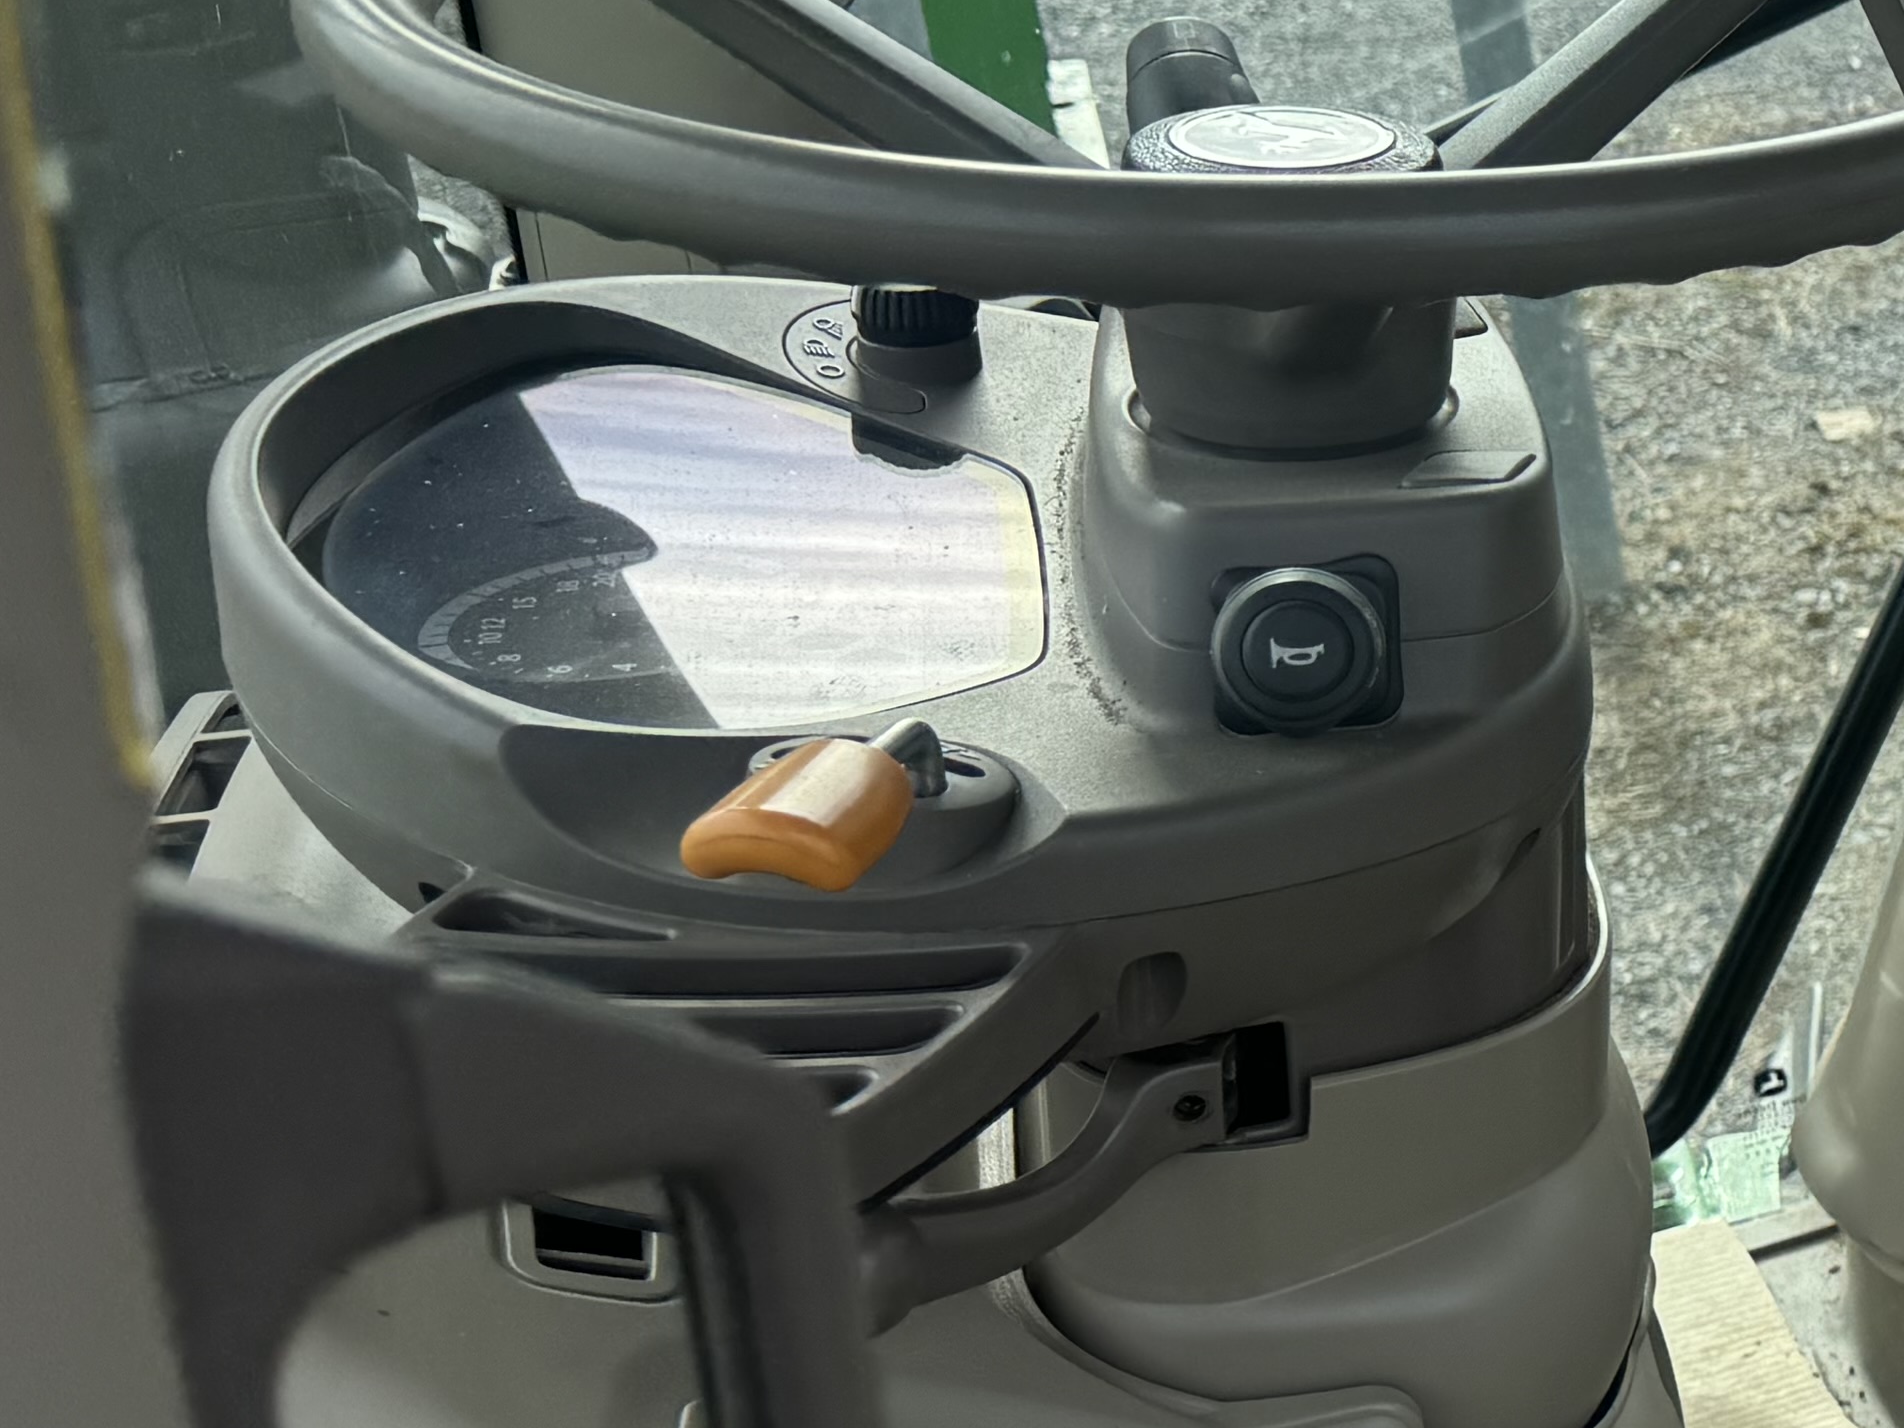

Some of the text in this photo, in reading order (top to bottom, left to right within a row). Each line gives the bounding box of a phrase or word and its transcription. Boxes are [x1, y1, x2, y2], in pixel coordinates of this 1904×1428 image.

[512, 595, 538, 610] 15
[480, 617, 506, 630] 12
[497, 653, 522, 663] 8
[548, 664, 573, 674] 6
[612, 662, 638, 672] 4
